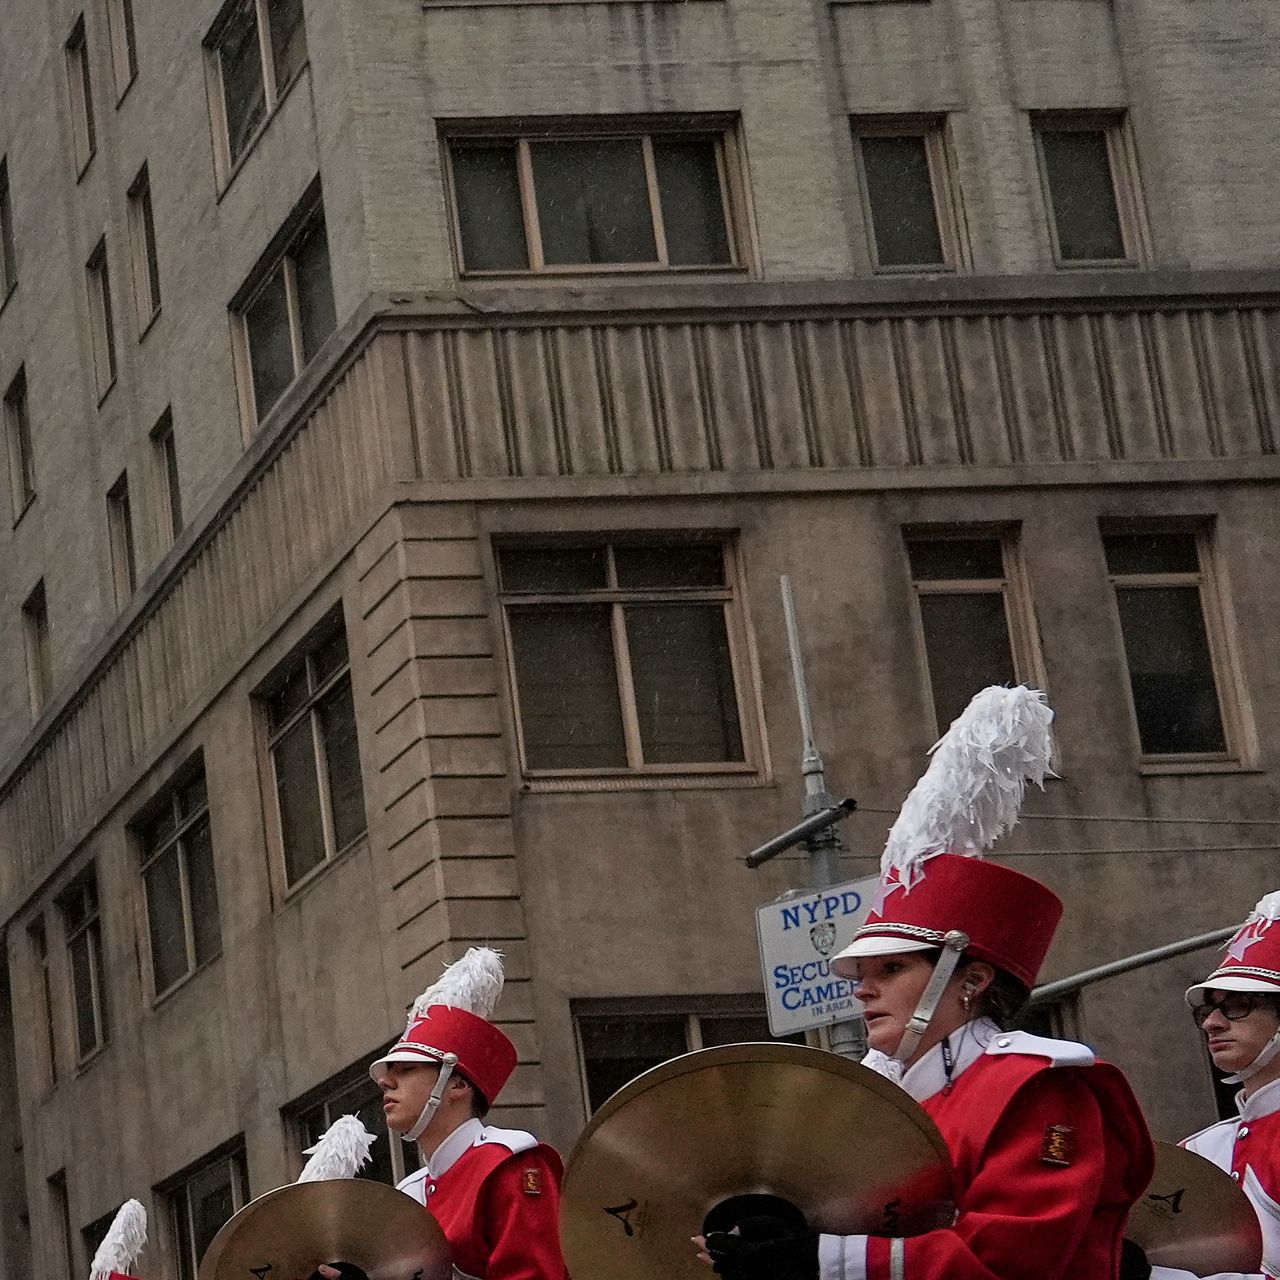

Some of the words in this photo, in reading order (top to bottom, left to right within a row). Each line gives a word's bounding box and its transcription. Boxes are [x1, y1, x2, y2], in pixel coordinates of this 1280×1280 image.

[780, 891, 862, 931] NYPD
[773, 959, 830, 989] SECU
[826, 998, 854, 1013] AREA
